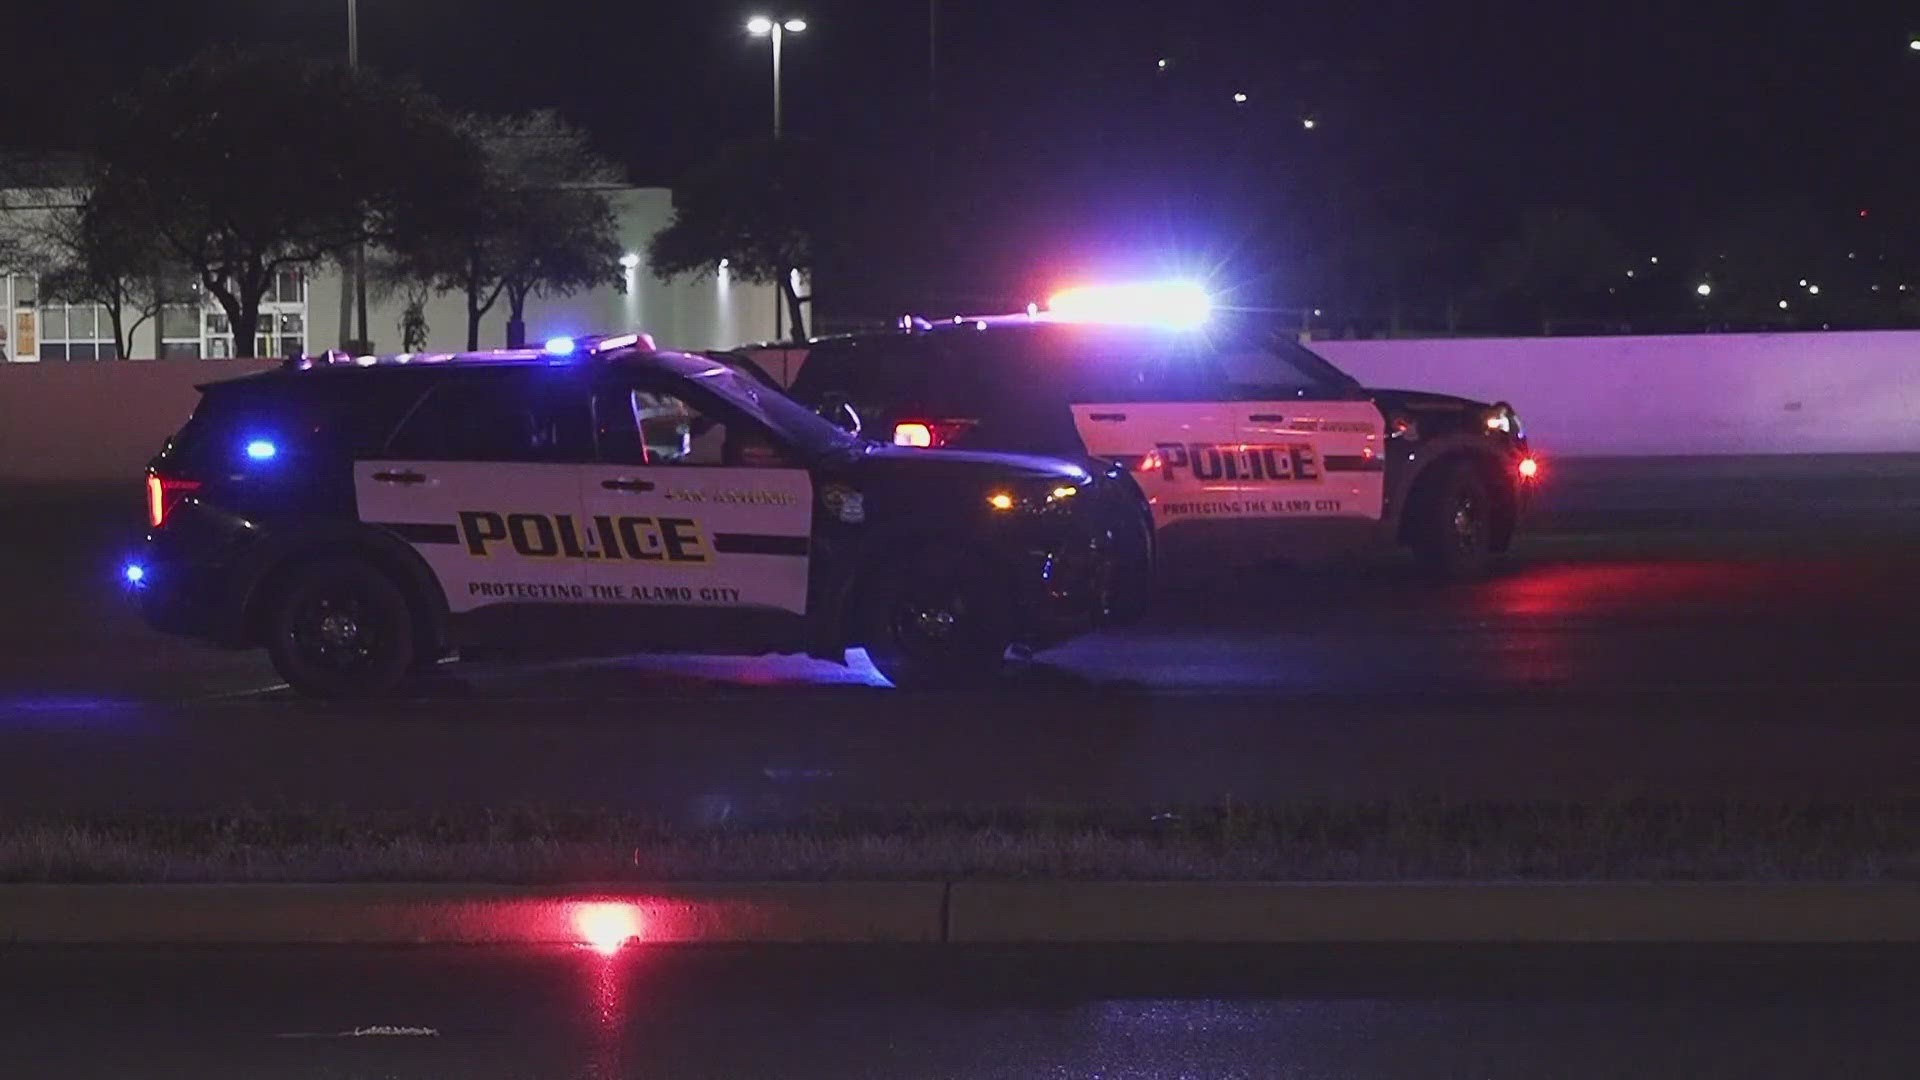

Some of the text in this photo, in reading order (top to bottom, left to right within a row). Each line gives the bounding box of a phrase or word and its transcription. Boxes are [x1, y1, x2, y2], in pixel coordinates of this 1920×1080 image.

[1156, 442, 1319, 481] POLICE
[1162, 501, 1342, 515] PROTECTING THE ALAMO CITY
[458, 511, 706, 563] POLICE
[468, 581, 741, 602] PROTECTING THE ALAMO CITY
